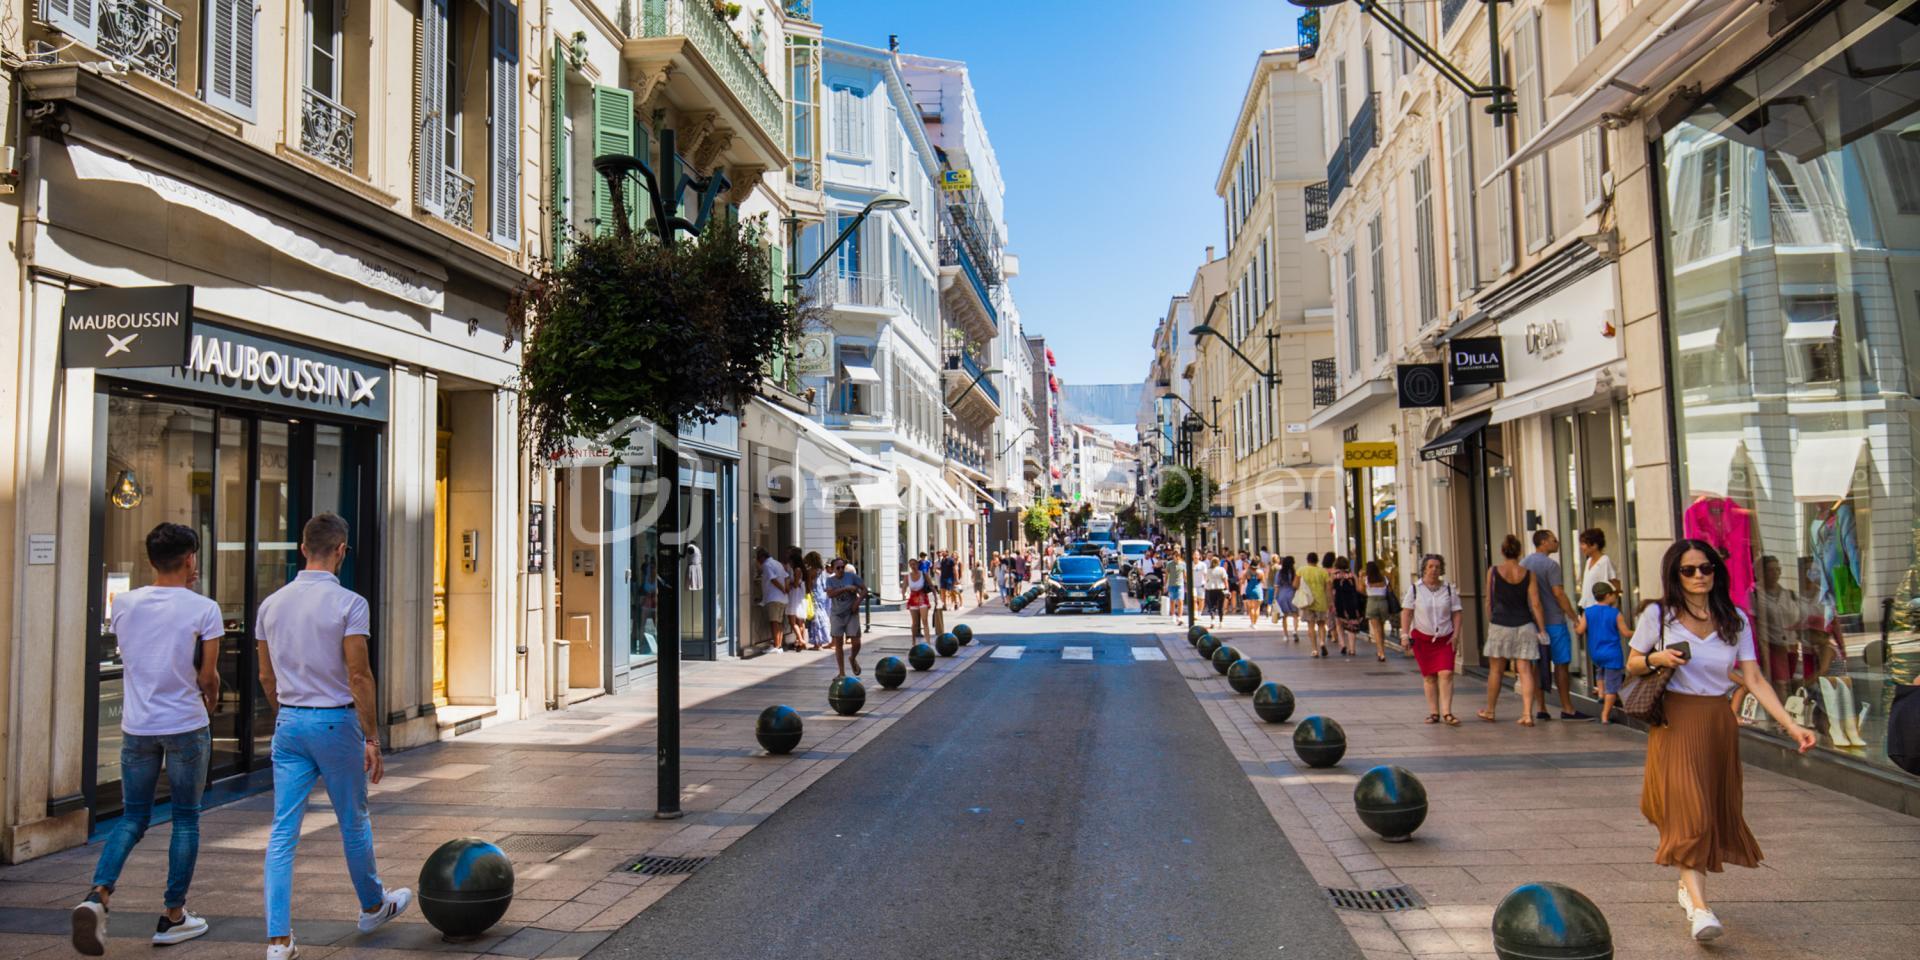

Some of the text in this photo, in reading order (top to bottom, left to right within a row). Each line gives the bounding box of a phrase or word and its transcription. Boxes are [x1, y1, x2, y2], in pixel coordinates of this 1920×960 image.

[69, 312, 179, 330] MAUBOUSSIN
[1456, 351, 1499, 367] DJULA
[1346, 449, 1393, 461] BOCAGE
